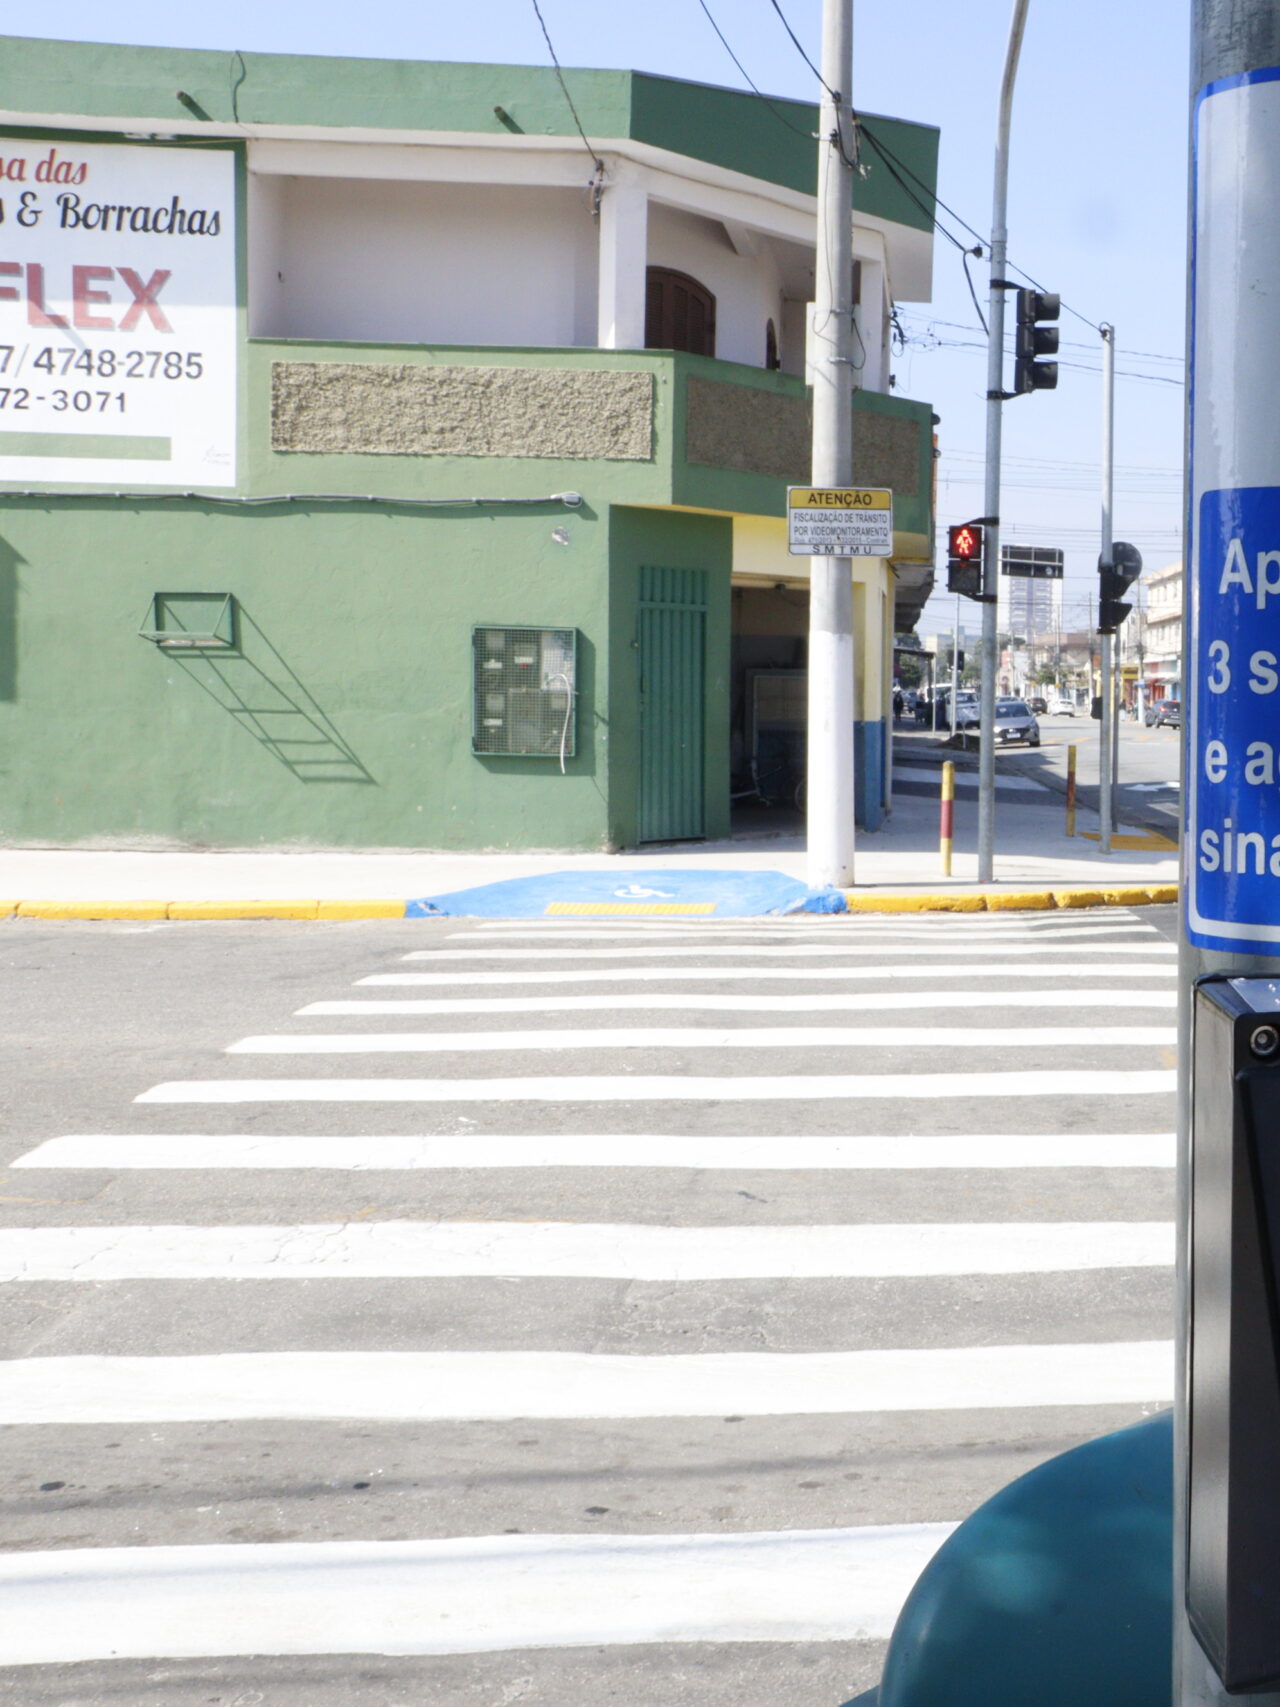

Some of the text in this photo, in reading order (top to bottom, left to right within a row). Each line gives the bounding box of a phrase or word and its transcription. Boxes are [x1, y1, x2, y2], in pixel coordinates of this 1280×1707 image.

[35, 148, 87, 185] das
[16, 191, 43, 227] &
[56, 192, 221, 236] Borrachas
[808, 489, 872, 508] ATENÇÃO
[794, 511, 887, 524] FISCALIZAÇÃO DE TRÂNSITO
[794, 526, 889, 537] POR VIDEOMONITORAMENTO
[1208, 639, 1231, 694] 3
[1204, 740, 1228, 784] e
